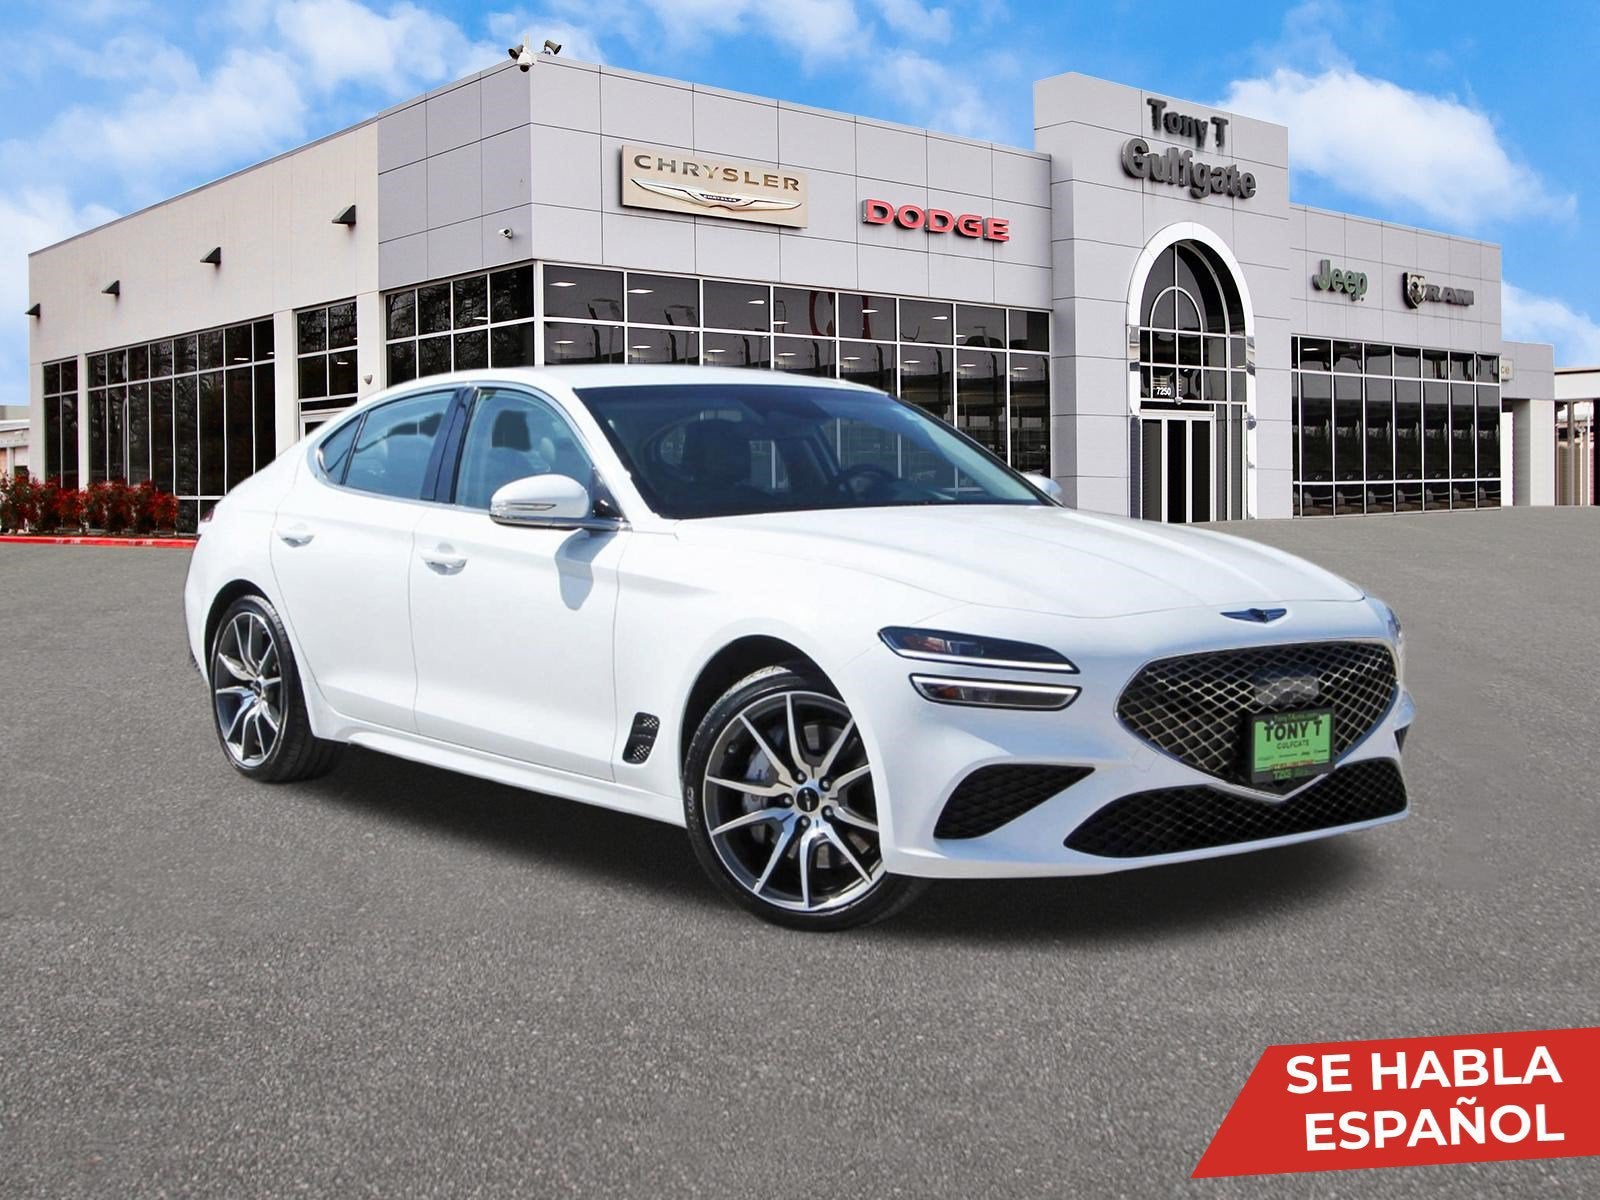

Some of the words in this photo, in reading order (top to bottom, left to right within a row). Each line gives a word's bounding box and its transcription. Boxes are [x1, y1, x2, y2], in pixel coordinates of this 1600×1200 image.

[1147, 98, 1208, 148] Tony
[1210, 116, 1229, 147] T
[633, 153, 801, 192] CHRYSLER
[1120, 138, 1256, 199] Gulfgate
[862, 198, 1010, 242] DODGE
[1312, 259, 1367, 302] Jeep
[1425, 284, 1474, 306] RAM
[1264, 722, 1308, 742] TONY
[1314, 720, 1322, 736] T
